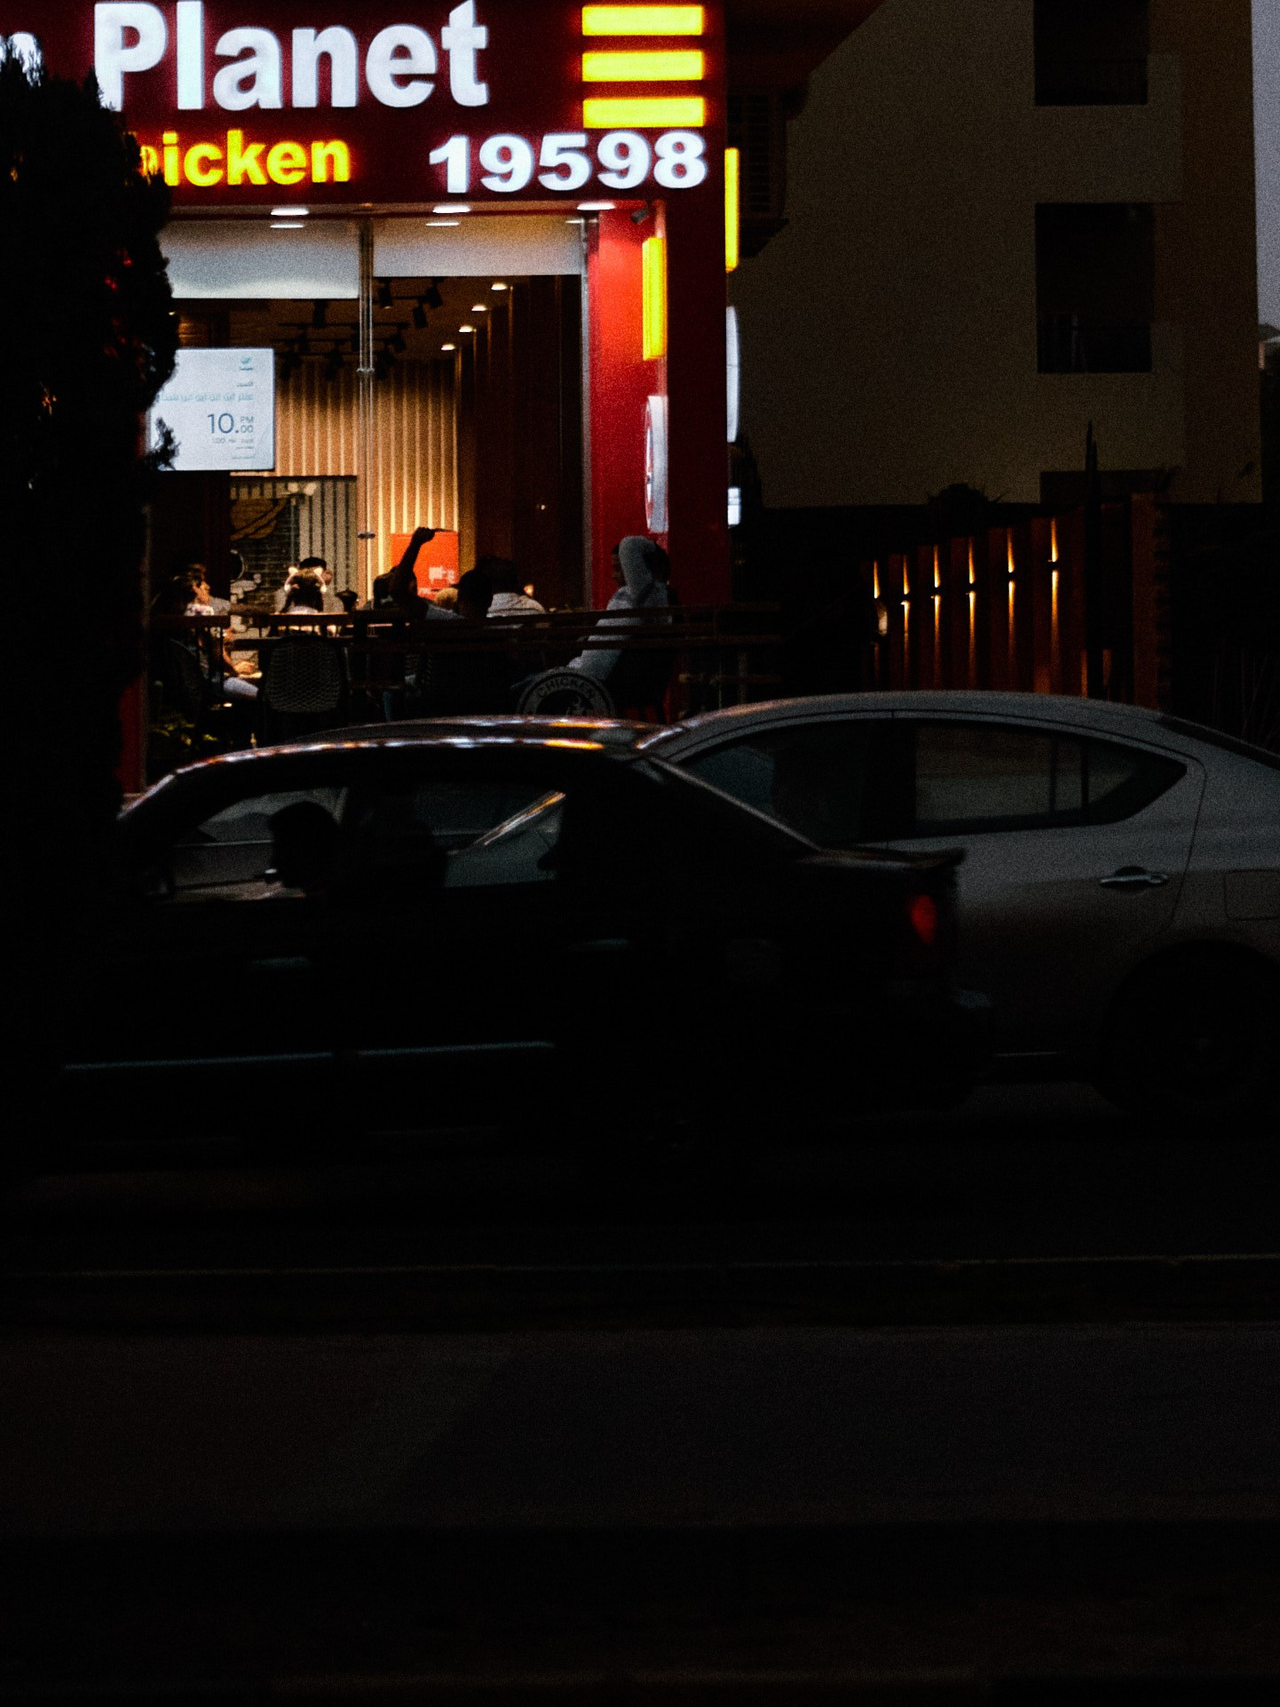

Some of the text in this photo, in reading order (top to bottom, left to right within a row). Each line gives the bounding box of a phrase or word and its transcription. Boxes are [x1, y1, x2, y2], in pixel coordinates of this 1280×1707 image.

[95, 0, 487, 111] Planet
[430, 130, 707, 193] 19598
[537, 676, 596, 699] CHICKEN
